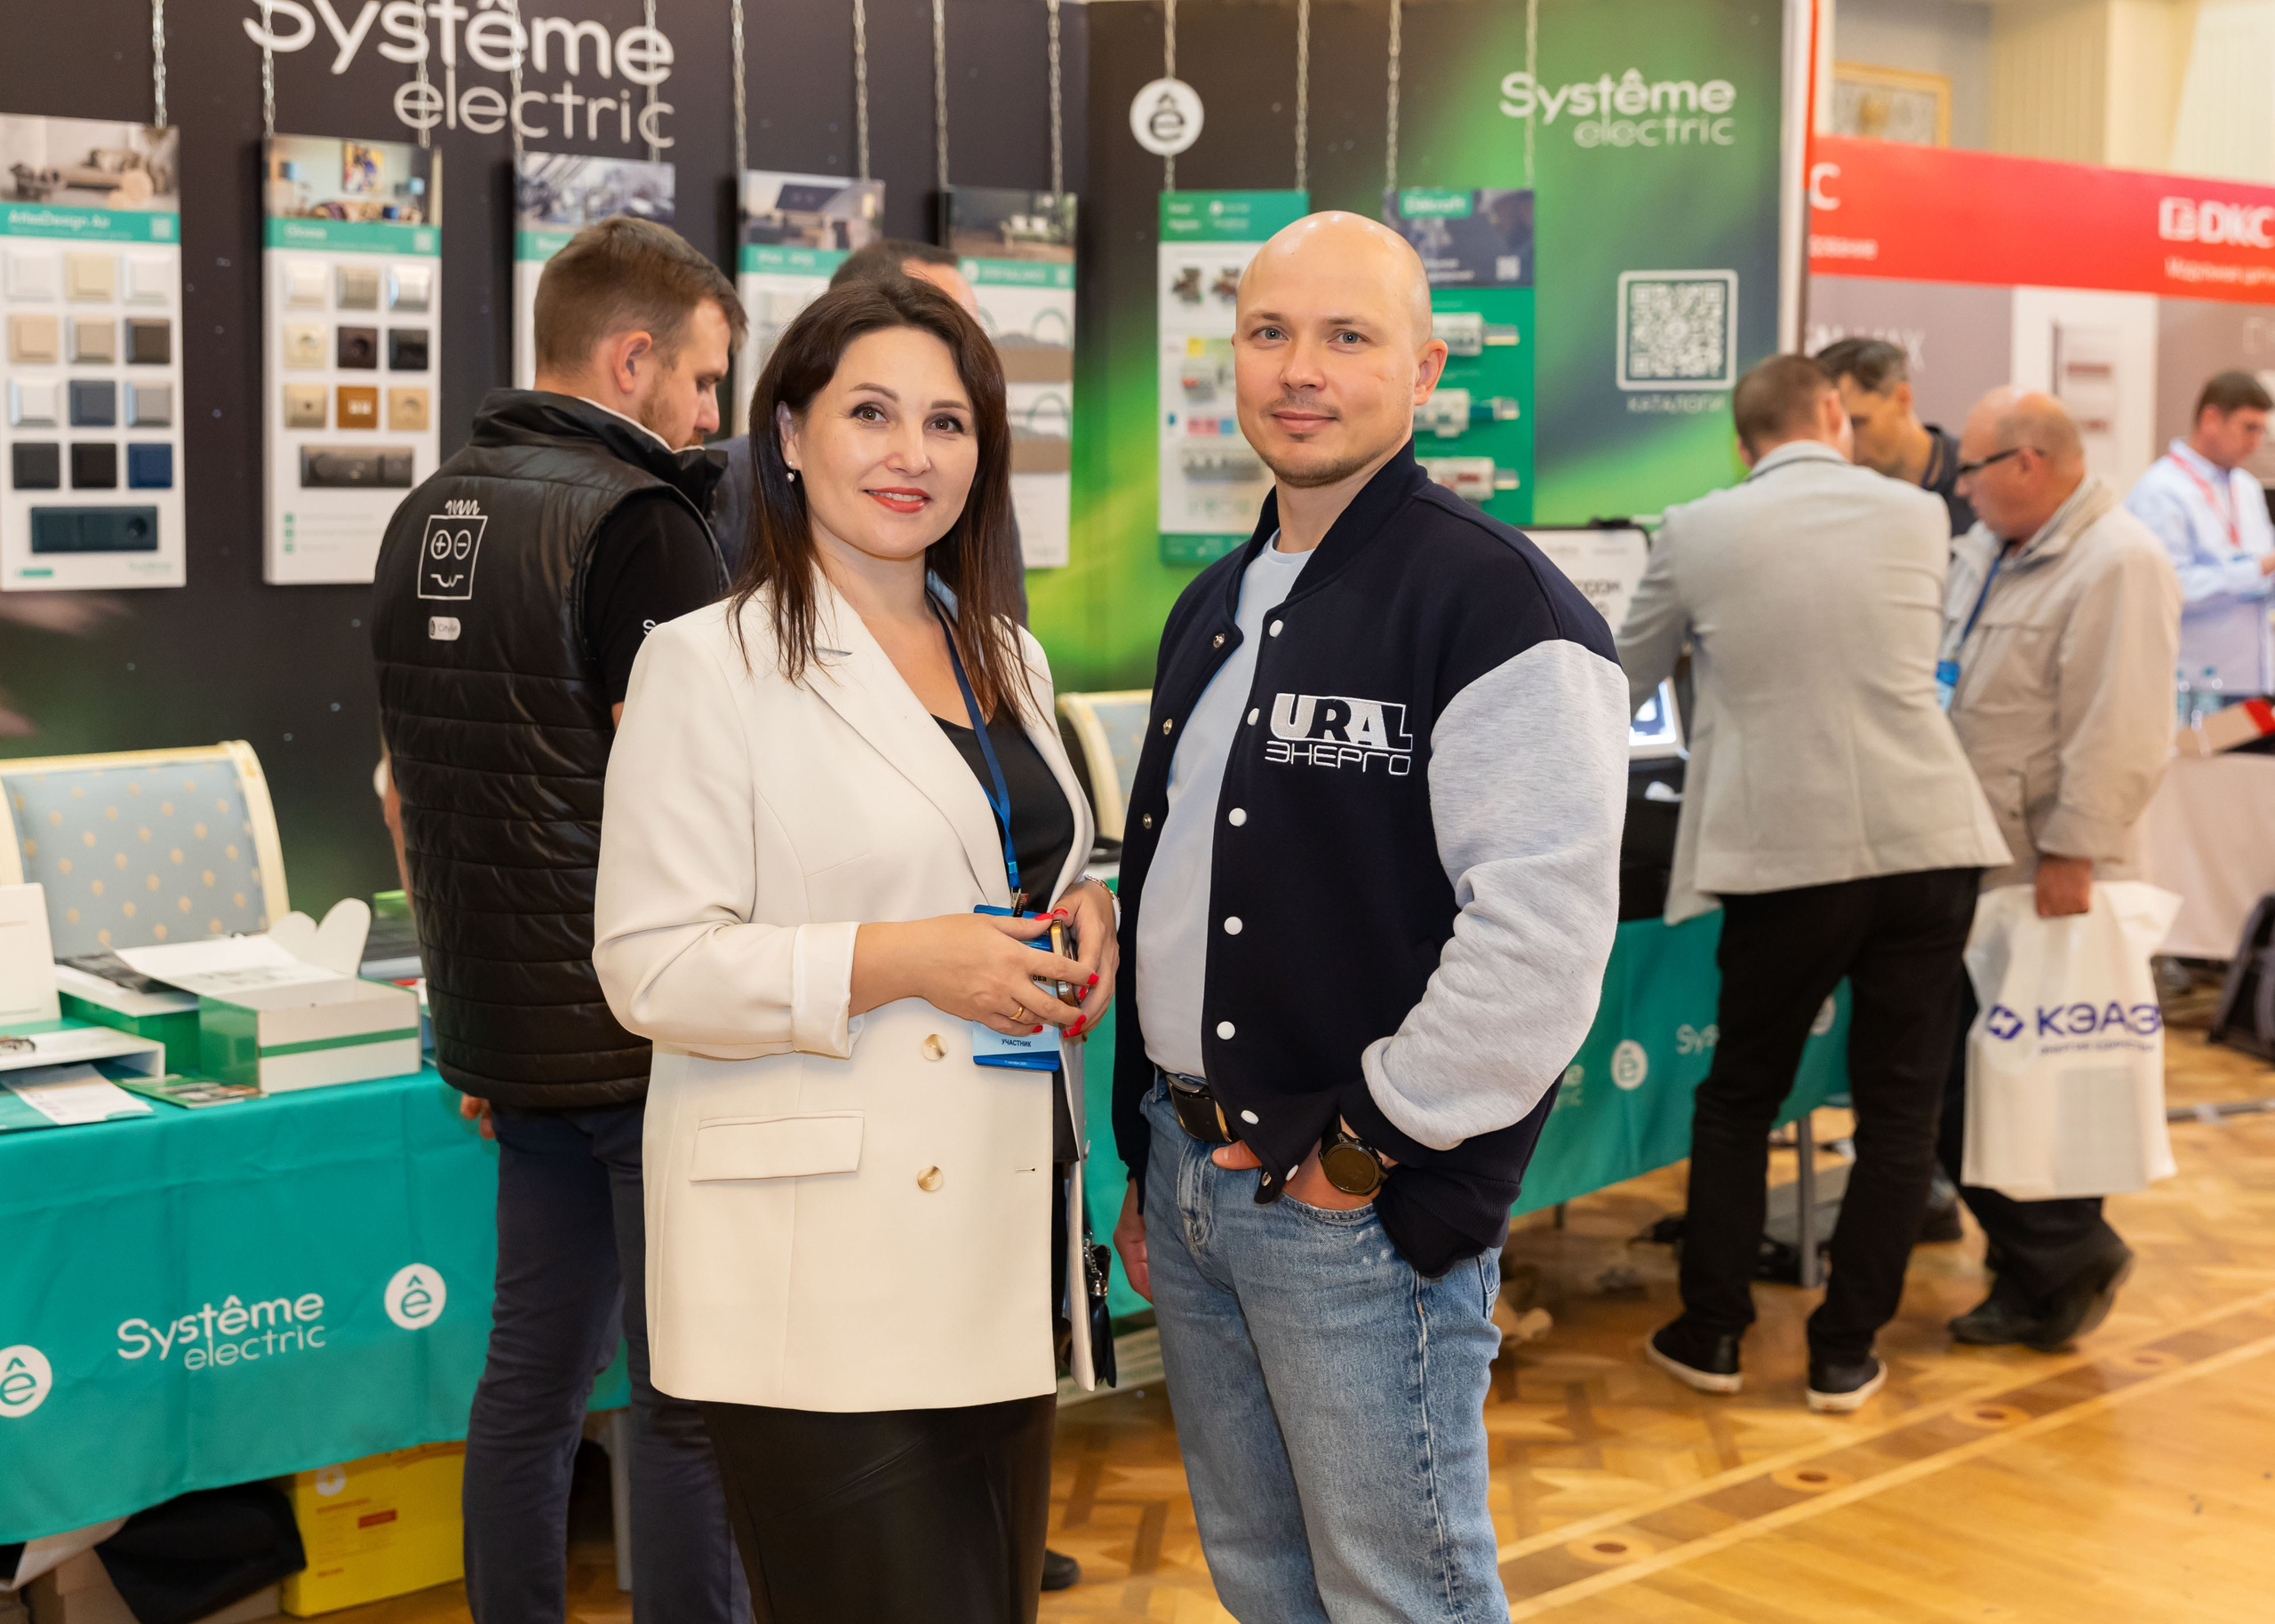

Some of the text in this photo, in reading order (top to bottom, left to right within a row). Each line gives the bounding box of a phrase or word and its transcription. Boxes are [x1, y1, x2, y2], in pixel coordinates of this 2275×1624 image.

[393, 67, 675, 148] electric
[1573, 115, 1736, 148] electric
[2199, 200, 2275, 249] DKC
[1270, 693, 1413, 752] URAL
[1002, 1039, 1032, 1047] УЧАСТНИК
[2038, 1001, 2161, 1038] КЭАЗ
[117, 1293, 325, 1360] Systême
[184, 1325, 326, 1371] electric
